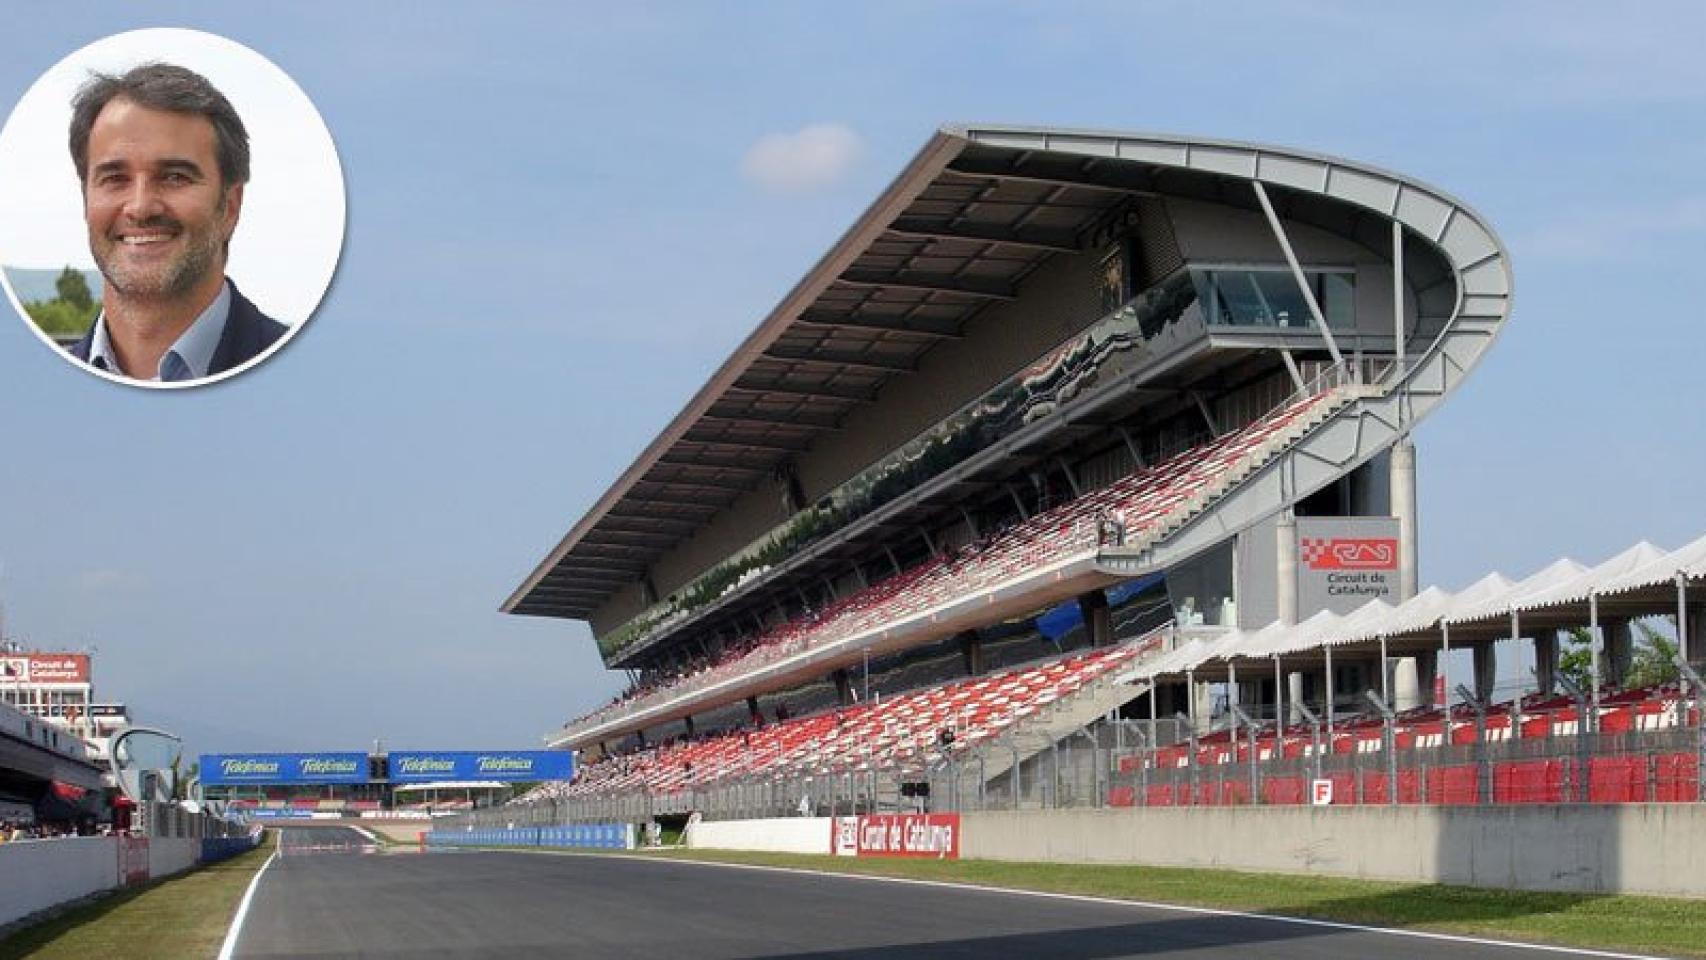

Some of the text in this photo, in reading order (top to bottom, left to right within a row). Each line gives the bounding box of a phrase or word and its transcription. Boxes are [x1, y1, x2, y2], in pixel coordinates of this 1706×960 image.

[1328, 573, 1385, 583] Circuit de
[1328, 584, 1389, 597] Catalunya
[1315, 783, 1329, 801] F
[861, 816, 952, 858] Circuit de Catalunya
